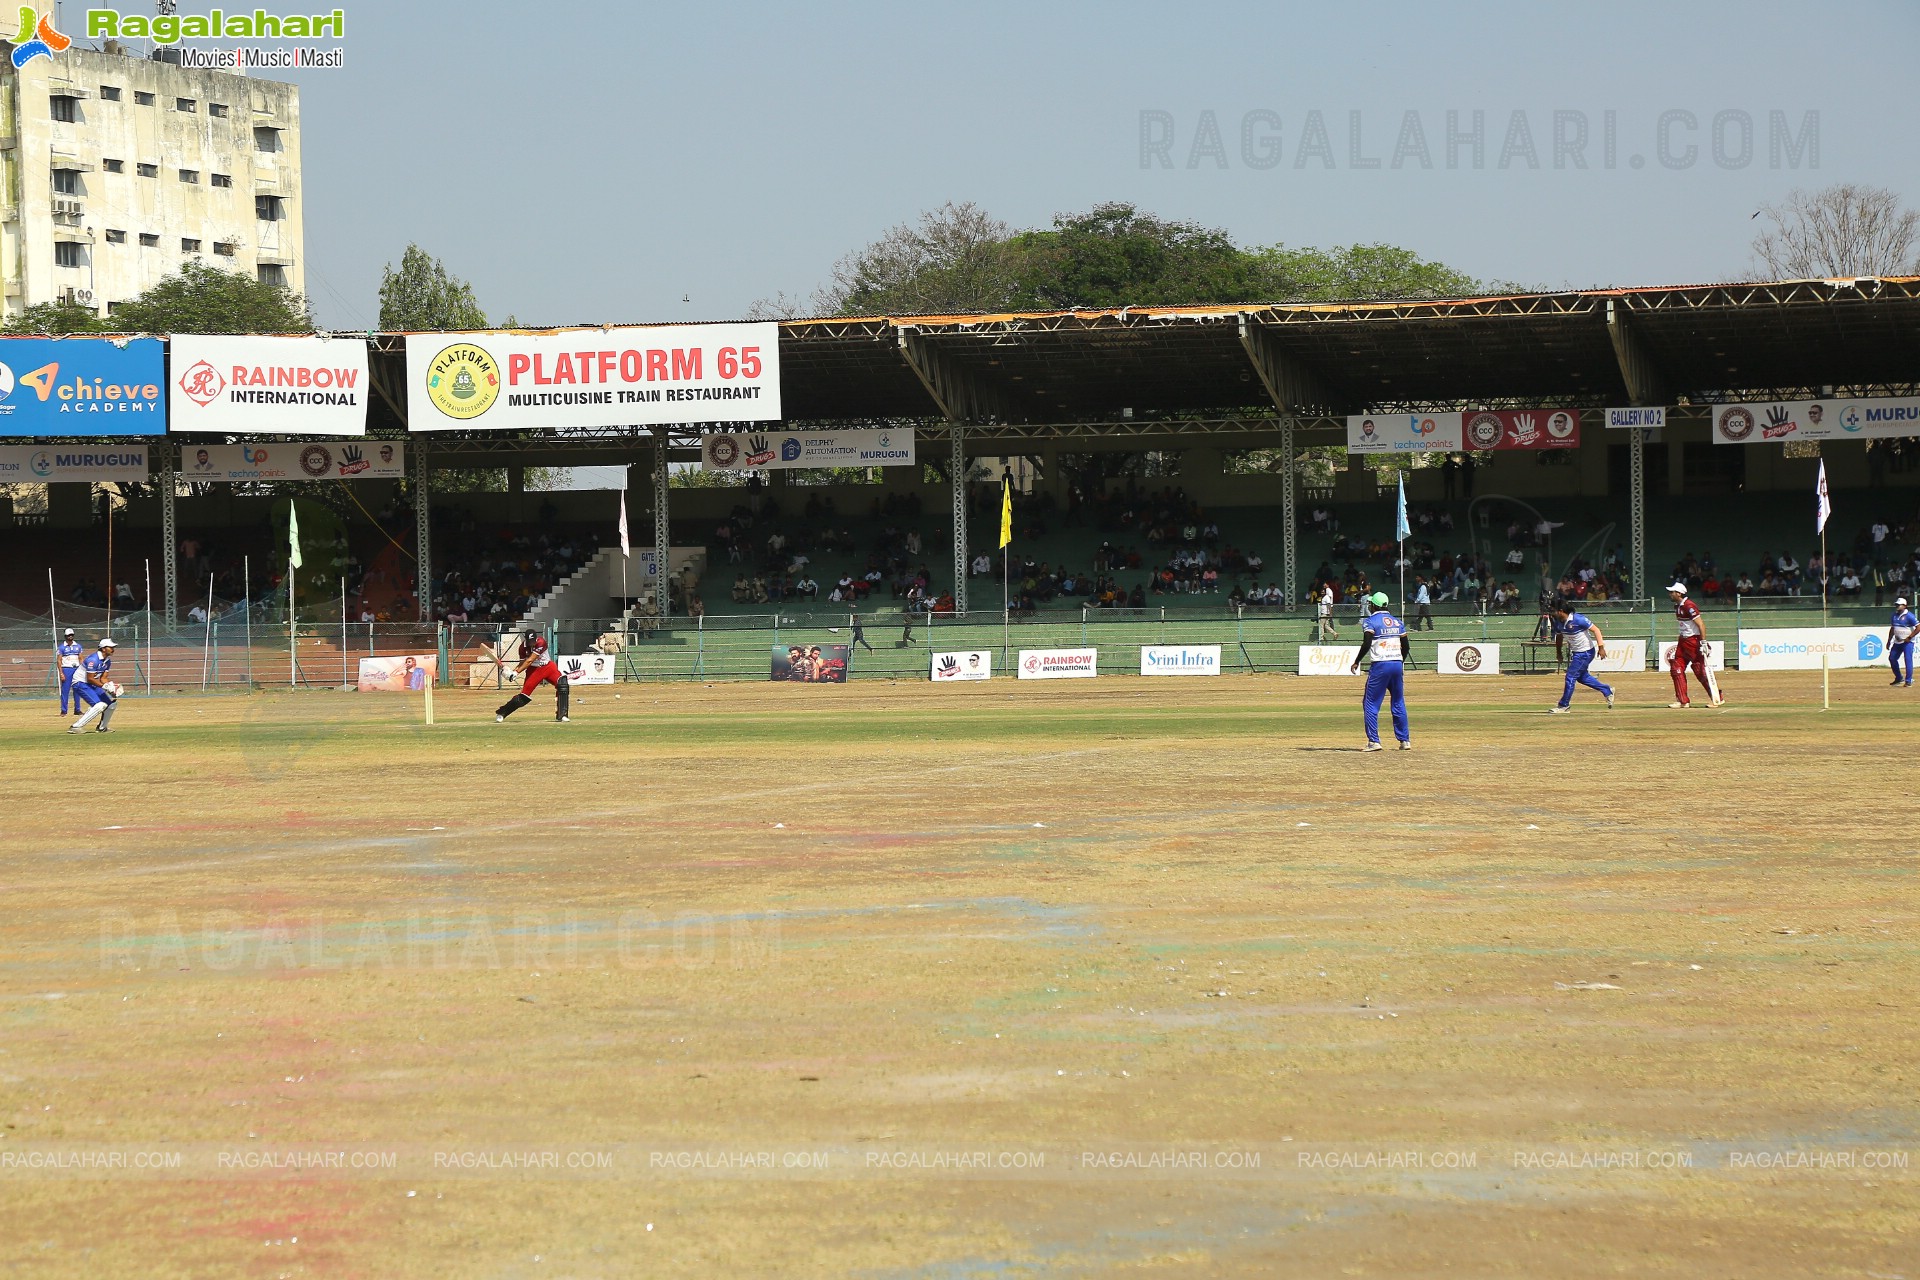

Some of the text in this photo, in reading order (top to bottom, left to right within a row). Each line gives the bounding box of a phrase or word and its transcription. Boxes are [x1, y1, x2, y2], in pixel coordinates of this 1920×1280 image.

[435, 350, 491, 374] PLATFORM
[508, 346, 762, 385] PLATFORM 65
[232, 366, 358, 389] RAINBOW
[458, 375, 469, 384] 65
[231, 390, 357, 406] INTERNATIONAL
[508, 386, 761, 406] MULTICUISINE TRAIN RESTAURANT
[60, 402, 157, 413] ACADEMY
[1866, 406, 1920, 421] MURU
[1611, 409, 1661, 425] GALLERY NO 2
[1514, 430, 1541, 445] DRUGS
[1766, 424, 1794, 438] DRUGS
[805, 439, 834, 447] DELPHY
[1394, 440, 1454, 450] technopaints
[805, 447, 857, 455] AUTOMATION
[860, 450, 909, 459] MURUGUN
[56, 454, 143, 467] MURUGUN
[749, 452, 775, 465] DRUGS
[228, 469, 286, 479] technopaints
[343, 461, 369, 474] DRUGS
[641, 552, 655, 561] GATE
[648, 563, 657, 574] 8
[1764, 642, 1845, 656] technopaints
[1043, 656, 1092, 665] RAINBOW
[1148, 651, 1213, 666] Srini Infra
[1309, 647, 1351, 672] Barfi
